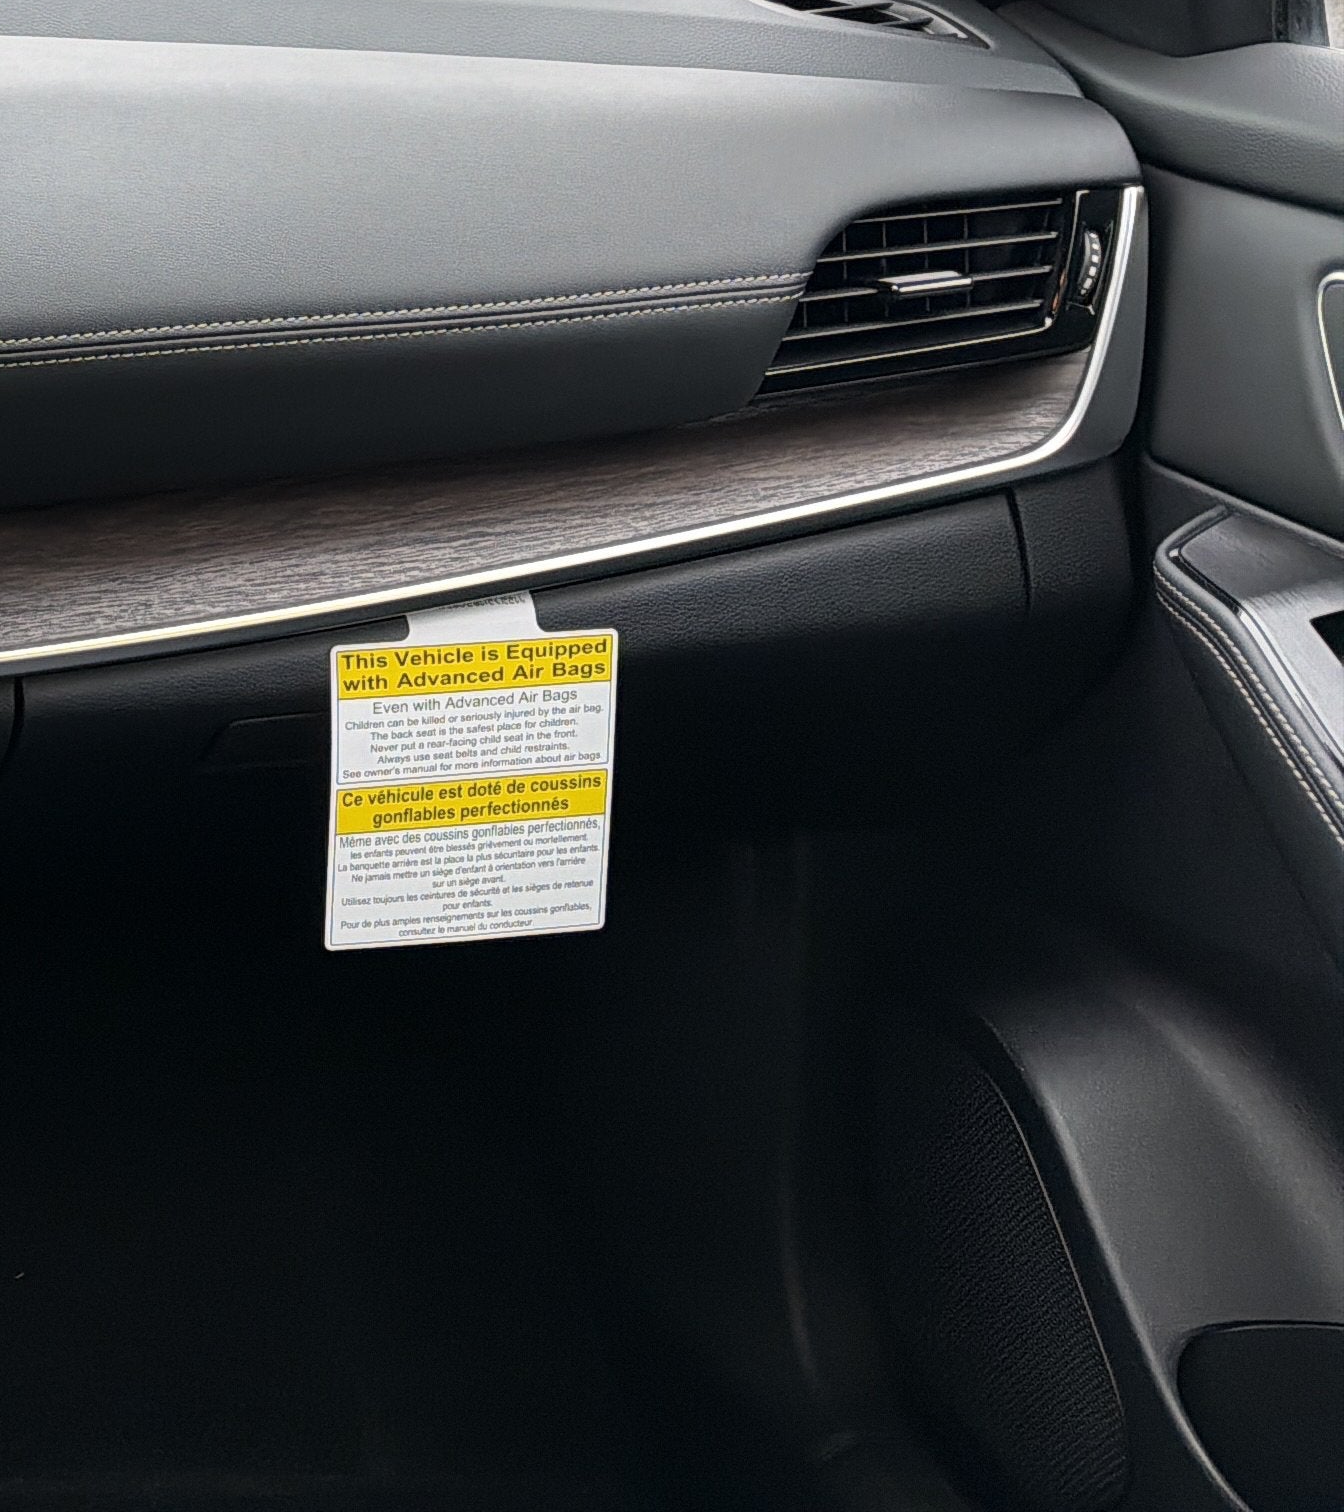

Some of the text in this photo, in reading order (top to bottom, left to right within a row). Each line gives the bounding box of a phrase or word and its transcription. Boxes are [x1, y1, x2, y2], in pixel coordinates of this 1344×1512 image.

[342, 638, 607, 670] This Vehicle is Equipped
[343, 662, 605, 691] with Advanced Air Bags
[373, 690, 577, 714] Even with Advanced Air Bags
[345, 720, 384, 731] Children
[387, 719, 404, 727] can
[407, 717, 419, 726] be
[422, 715, 445, 725] killed
[460, 711, 501, 722] seriously
[504, 709, 535, 720] injured
[538, 707, 549, 716] by
[552, 706, 566, 715] the
[569, 705, 580, 713] air
[584, 704, 603, 714] bag.
[370, 732, 388, 741] The
[391, 730, 413, 739] back
[416, 729, 436, 737] seat
[449, 726, 464, 735] the
[466, 724, 494, 734] safest
[497, 722, 521, 733] place
[524, 720, 536, 729] for
[539, 718, 578, 728] children.
[377, 755, 410, 764] Always
[433, 750, 453, 760] seat
[456, 749, 478, 758] belts
[480, 747, 497, 756] and
[501, 745, 522, 754] child
[524, 742, 570, 752] restraints.
[342, 774, 601, 807] Ce véhicule est doté de coussins
[373, 796, 569, 828] gonflables perfectionnés
[339, 818, 600, 849] Même avec des coussins gonflables perfectionnés,
